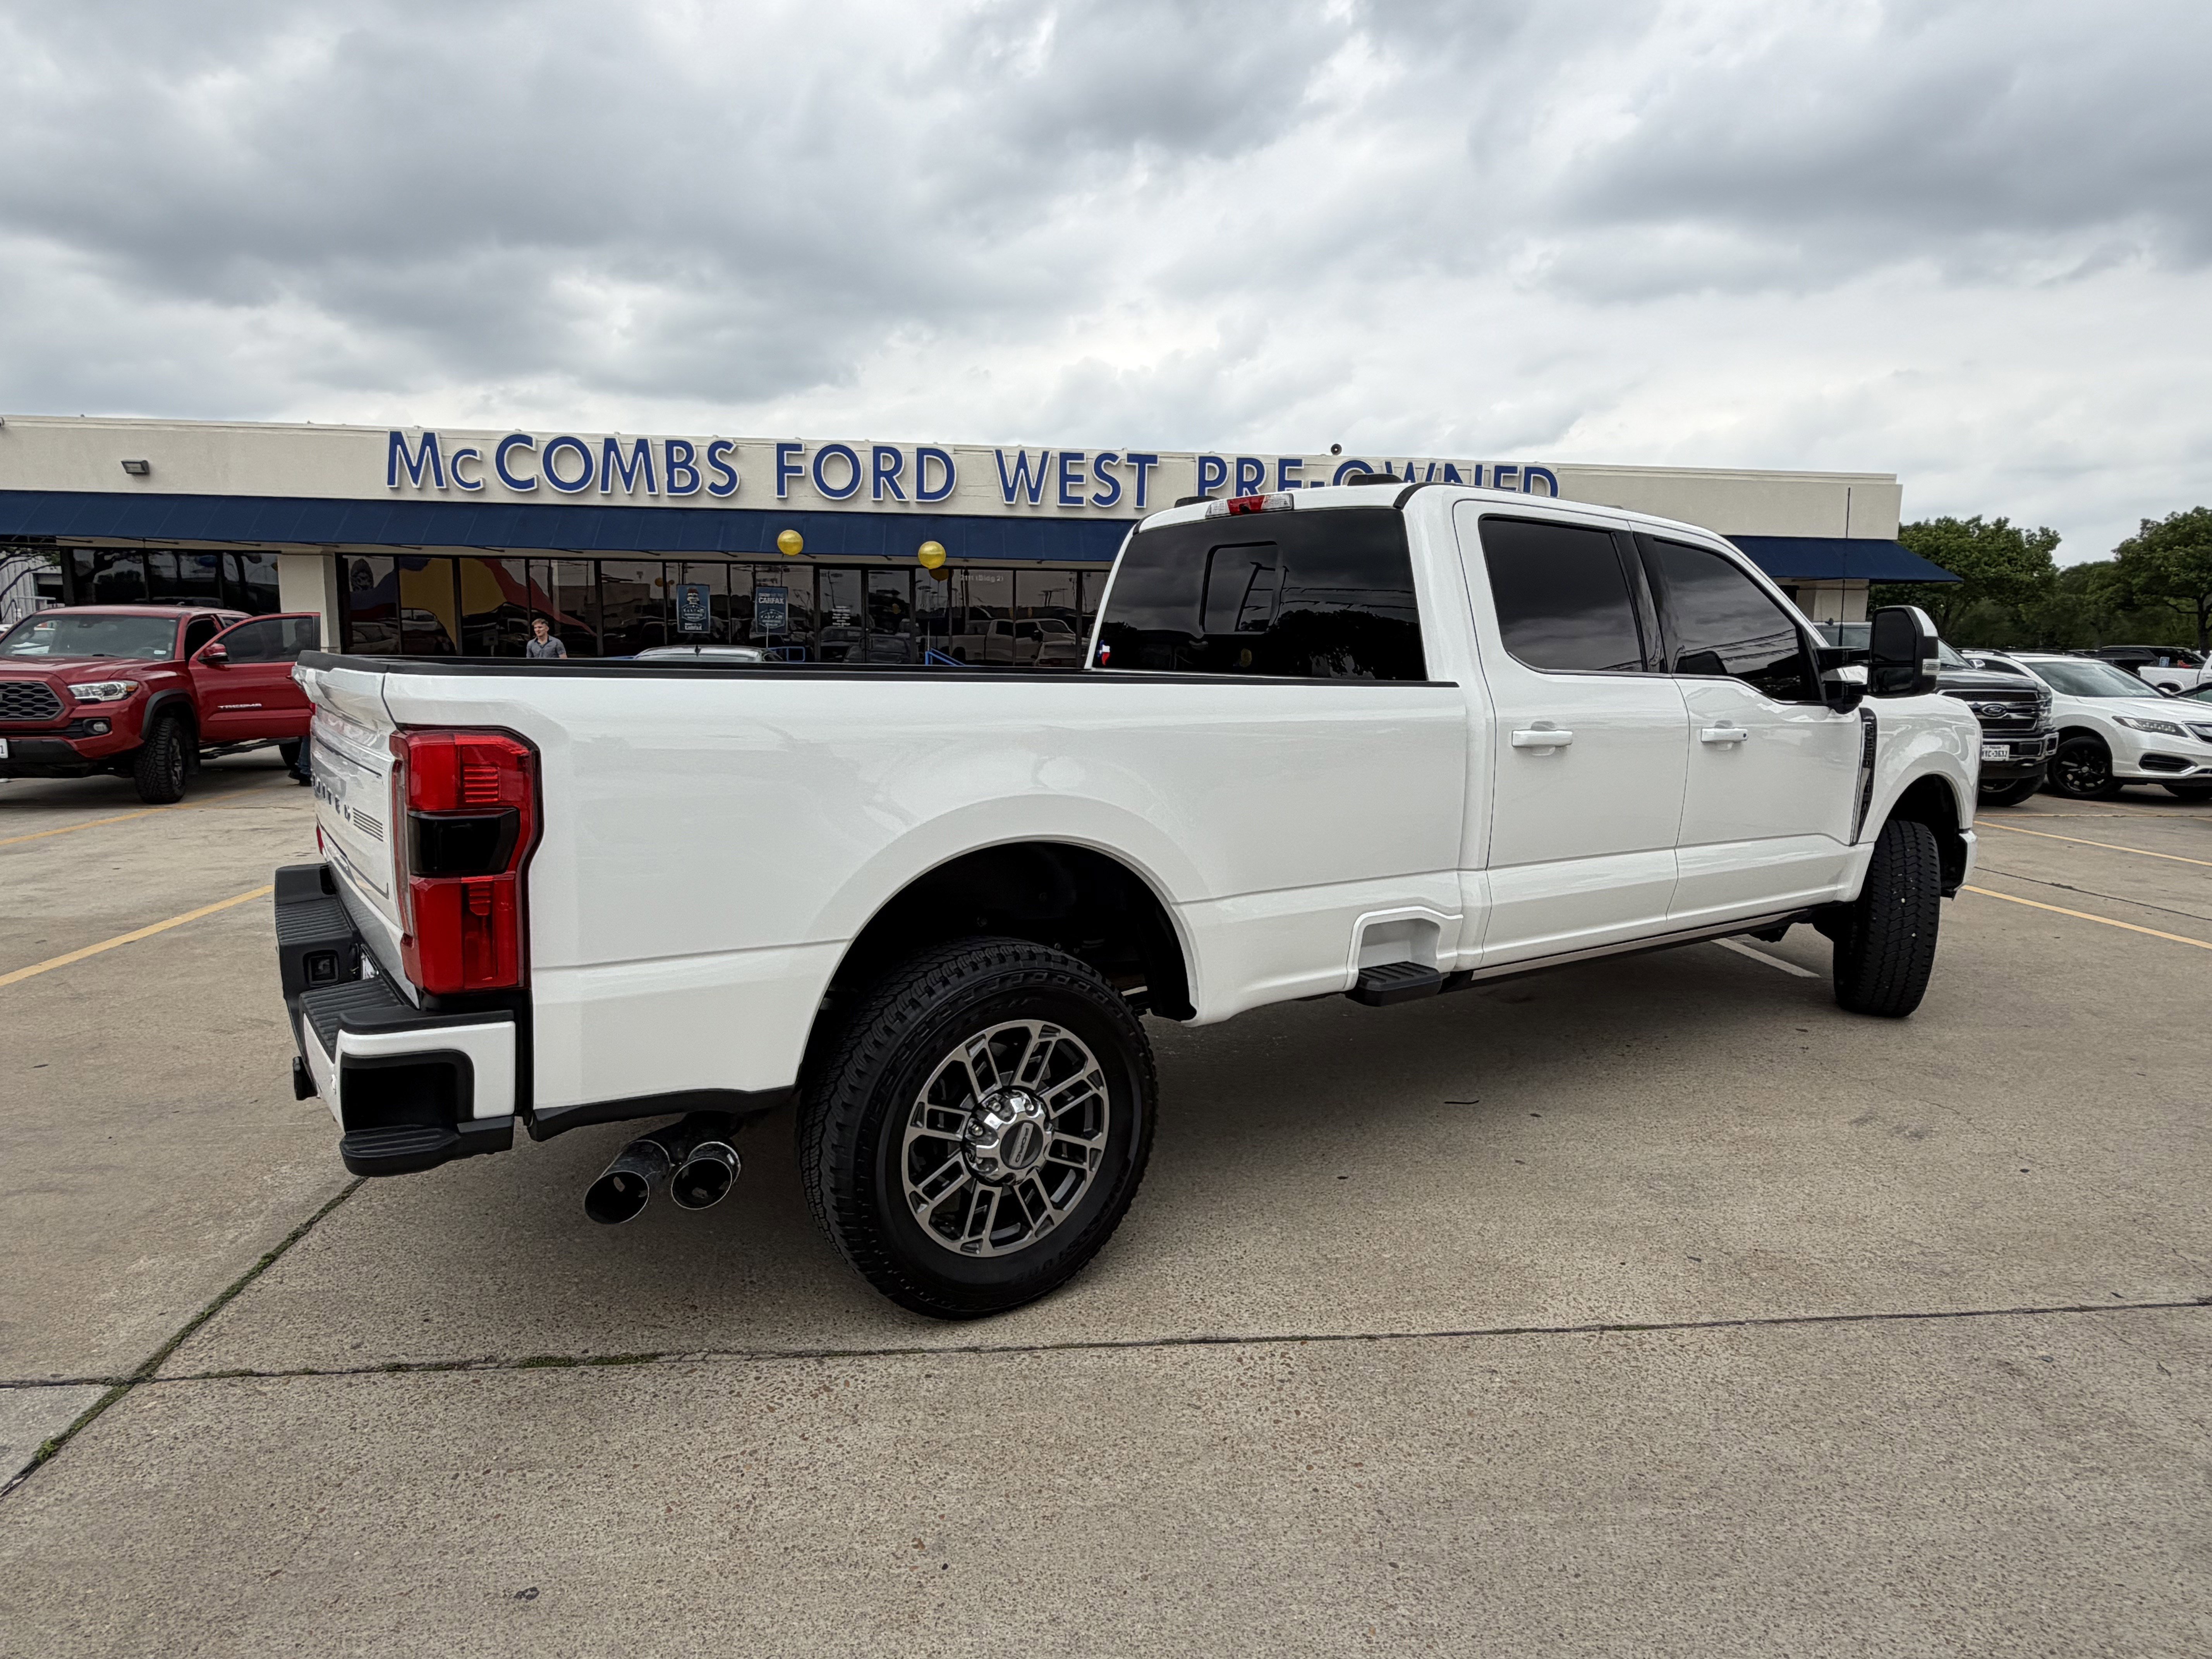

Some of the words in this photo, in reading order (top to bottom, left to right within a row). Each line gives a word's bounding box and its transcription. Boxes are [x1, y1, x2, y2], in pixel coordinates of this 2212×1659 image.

[386, 430, 740, 497] McCOMBS
[775, 442, 957, 502] FORD
[994, 448, 1159, 508] WEST
[1015, 1127, 1029, 1163] FORD
